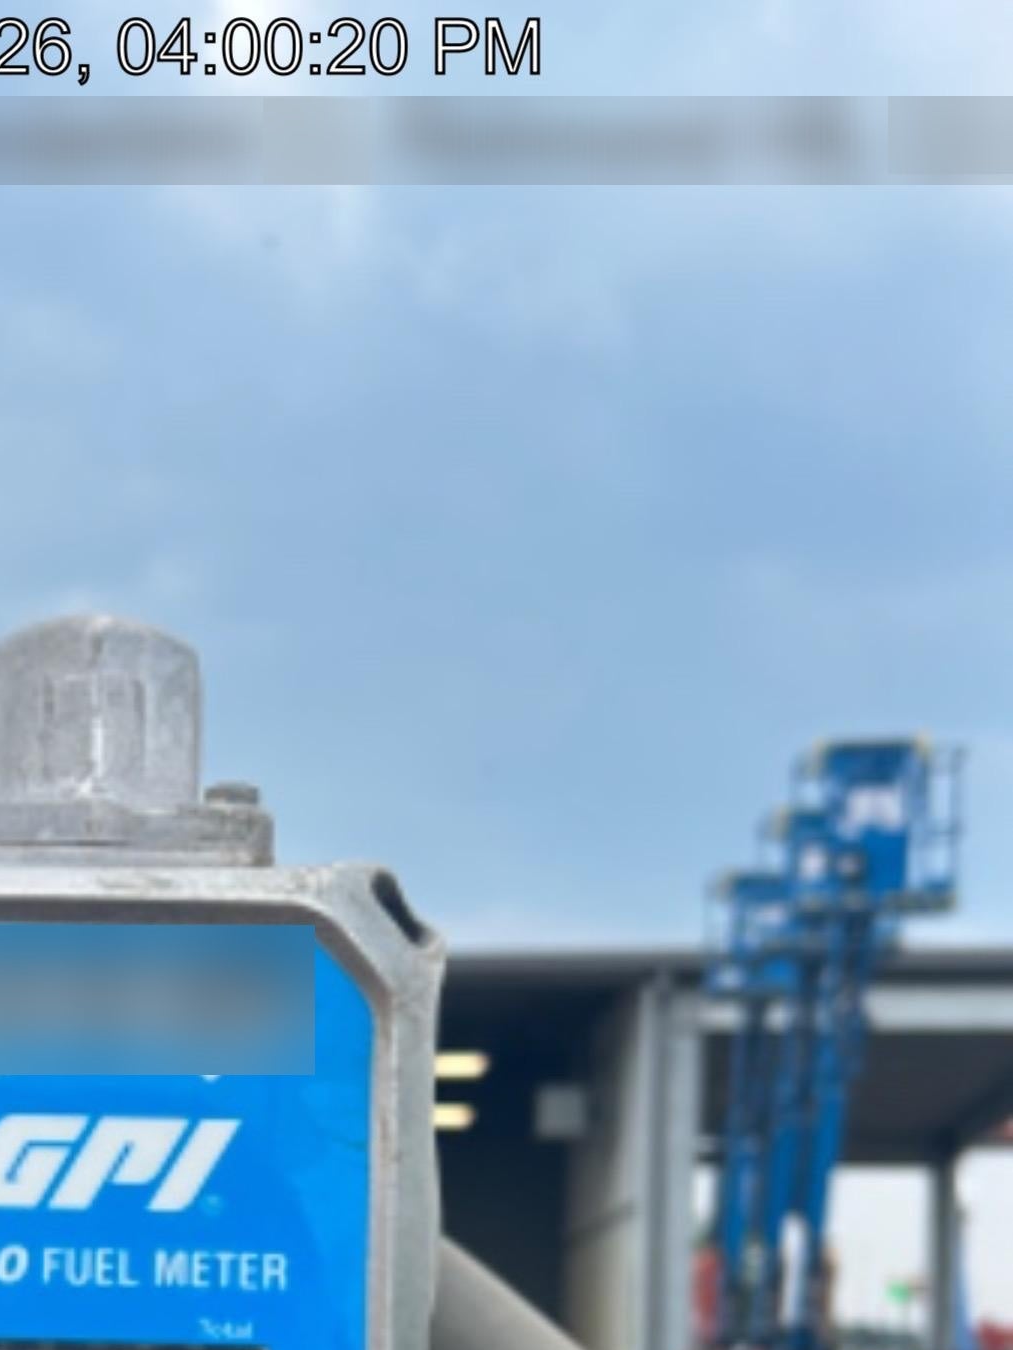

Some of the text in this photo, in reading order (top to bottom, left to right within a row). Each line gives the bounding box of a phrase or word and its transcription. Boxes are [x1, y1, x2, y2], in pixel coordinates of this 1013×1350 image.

[43, 1247, 140, 1287] FUEL
[153, 1250, 288, 1291] METER
[198, 1318, 253, 1340] Total
